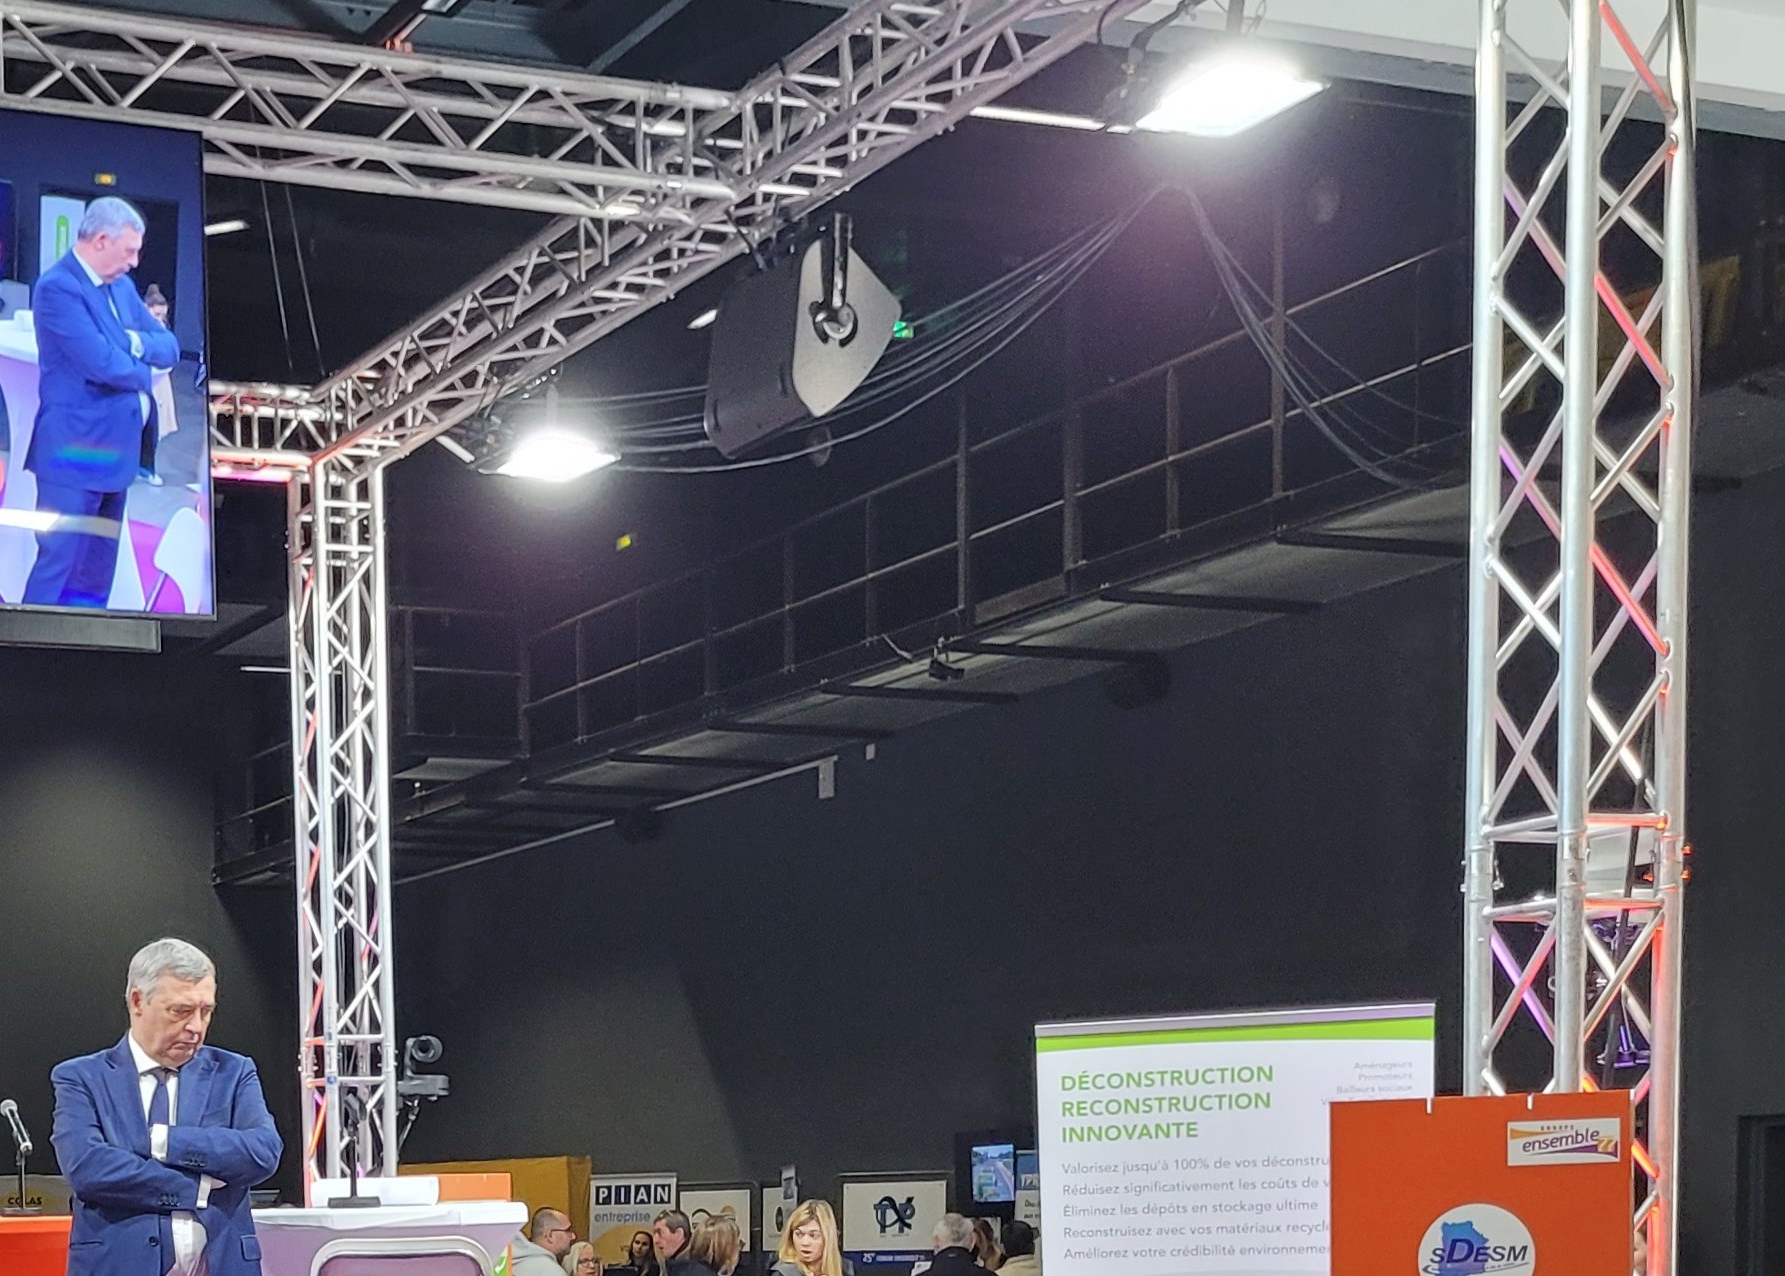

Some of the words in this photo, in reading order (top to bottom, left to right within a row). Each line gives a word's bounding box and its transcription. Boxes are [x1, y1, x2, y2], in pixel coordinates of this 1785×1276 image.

[1061, 1065, 1273, 1091] DÉCONSTRUCTION
[1062, 1092, 1271, 1117] RECONSTRUCTION
[1062, 1121, 1199, 1143] INNOVANTE
[1522, 1128, 1600, 1152] ensemble
[1061, 1162, 1119, 1174] Valorisez
[1122, 1160, 1169, 1175] jusqu'à
[1174, 1158, 1210, 1170] 100%
[1213, 1157, 1231, 1169] de
[1235, 1159, 1257, 1168] vos
[597, 1185, 670, 1204] PIAN
[1062, 1183, 1119, 1195] Réduisez
[1123, 1180, 1234, 1197] significativement
[1238, 1178, 1257, 1190] les
[1261, 1178, 1297, 1189] coûts
[1301, 1176, 1319, 1188] de
[594, 1211, 651, 1224] entreprise
[1063, 1203, 1116, 1217] Éliminez
[1120, 1203, 1138, 1215] les
[1142, 1203, 1188, 1217] dépôts
[1191, 1204, 1208, 1213] en
[1212, 1200, 1272, 1215] stockage
[1276, 1199, 1318, 1211] ultime
[1063, 1226, 1153, 1239] Reconstruisez
[1156, 1226, 1186, 1236] avec
[1189, 1226, 1212, 1235] vos
[1216, 1222, 1282, 1234] matériaux
[1063, 1247, 1129, 1259] Améliorez
[1132, 1248, 1167, 1257] votre
[1170, 1245, 1236, 1257] crédibilité
[1239, 1244, 1329, 1256] environneme
